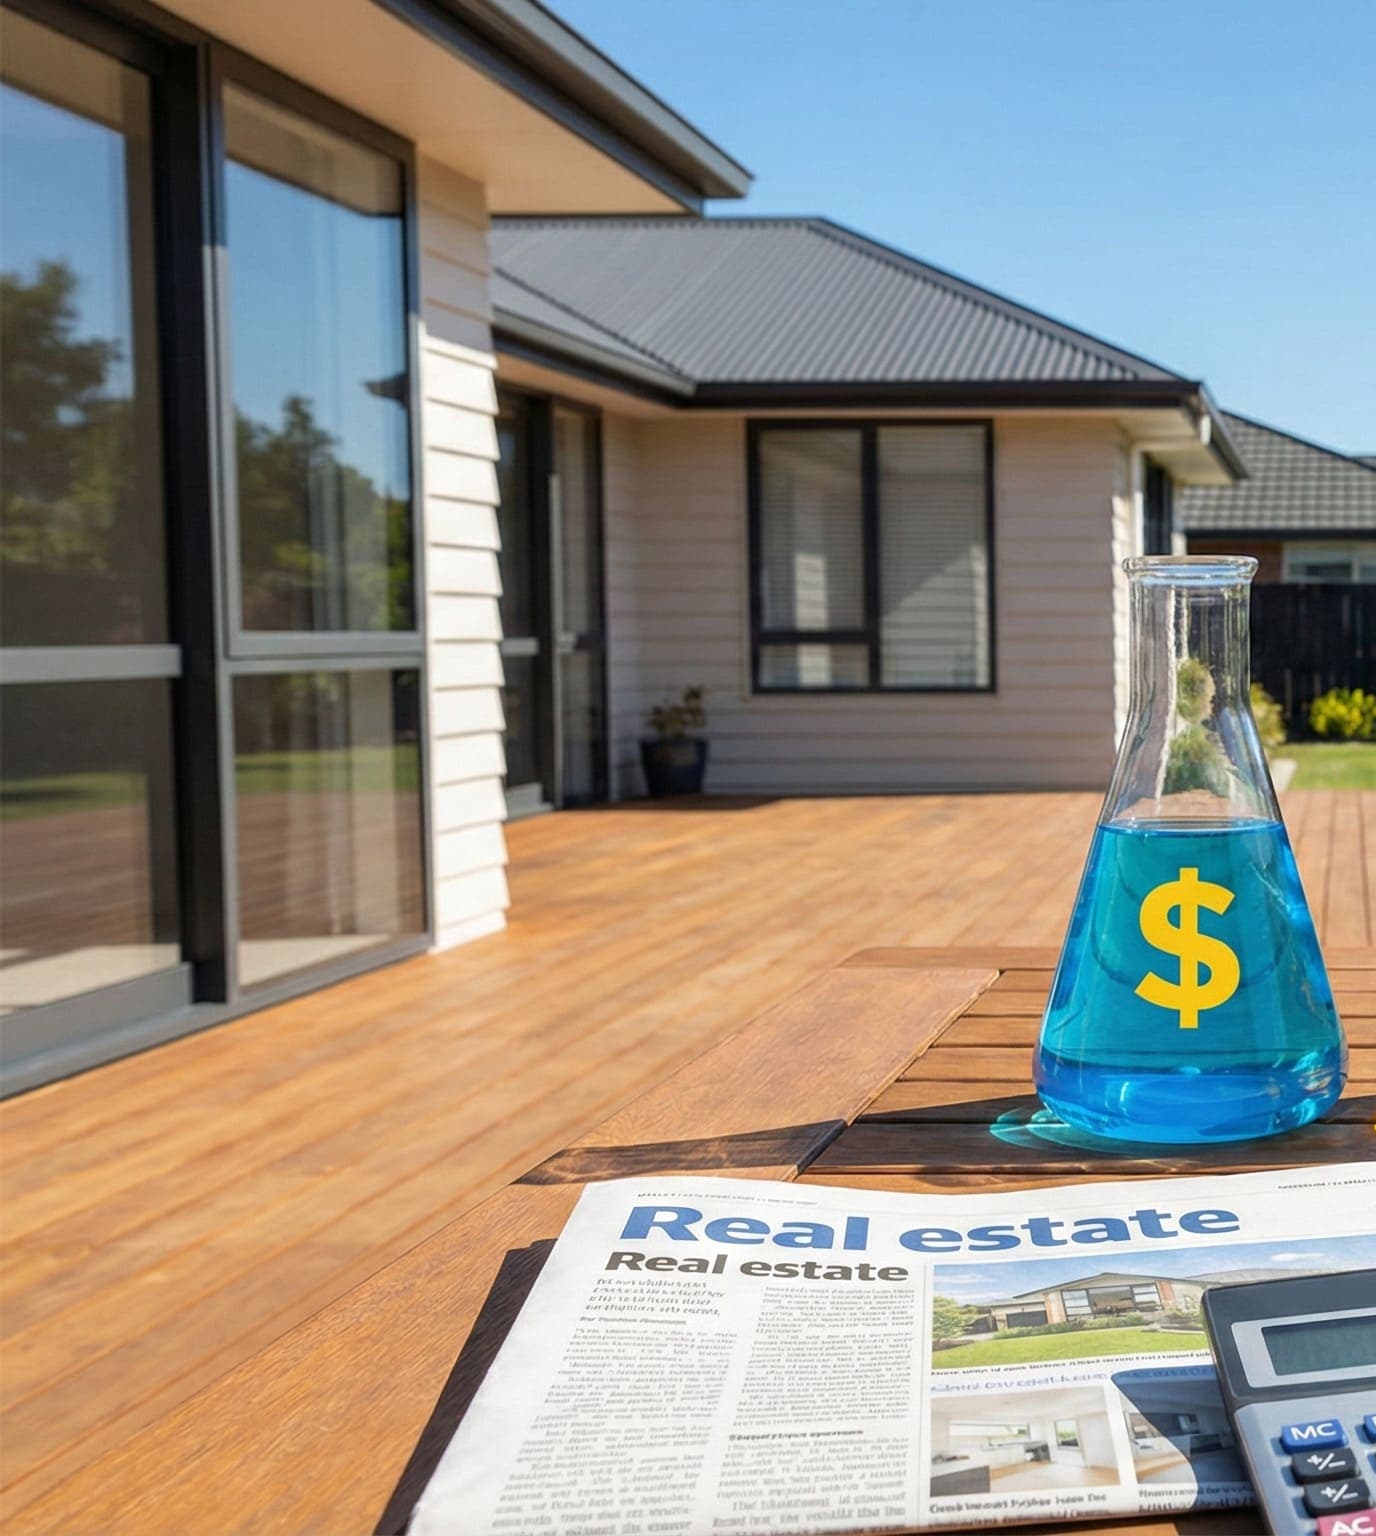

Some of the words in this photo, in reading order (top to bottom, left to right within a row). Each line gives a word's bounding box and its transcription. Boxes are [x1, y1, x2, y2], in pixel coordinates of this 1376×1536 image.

[619, 1205, 869, 1251] Real
[898, 1206, 1241, 1254] estate
[604, 1250, 728, 1276] Real
[739, 1261, 909, 1283] estate
[1290, 1423, 1337, 1440] MC
[1331, 1516, 1375, 1536] AC
